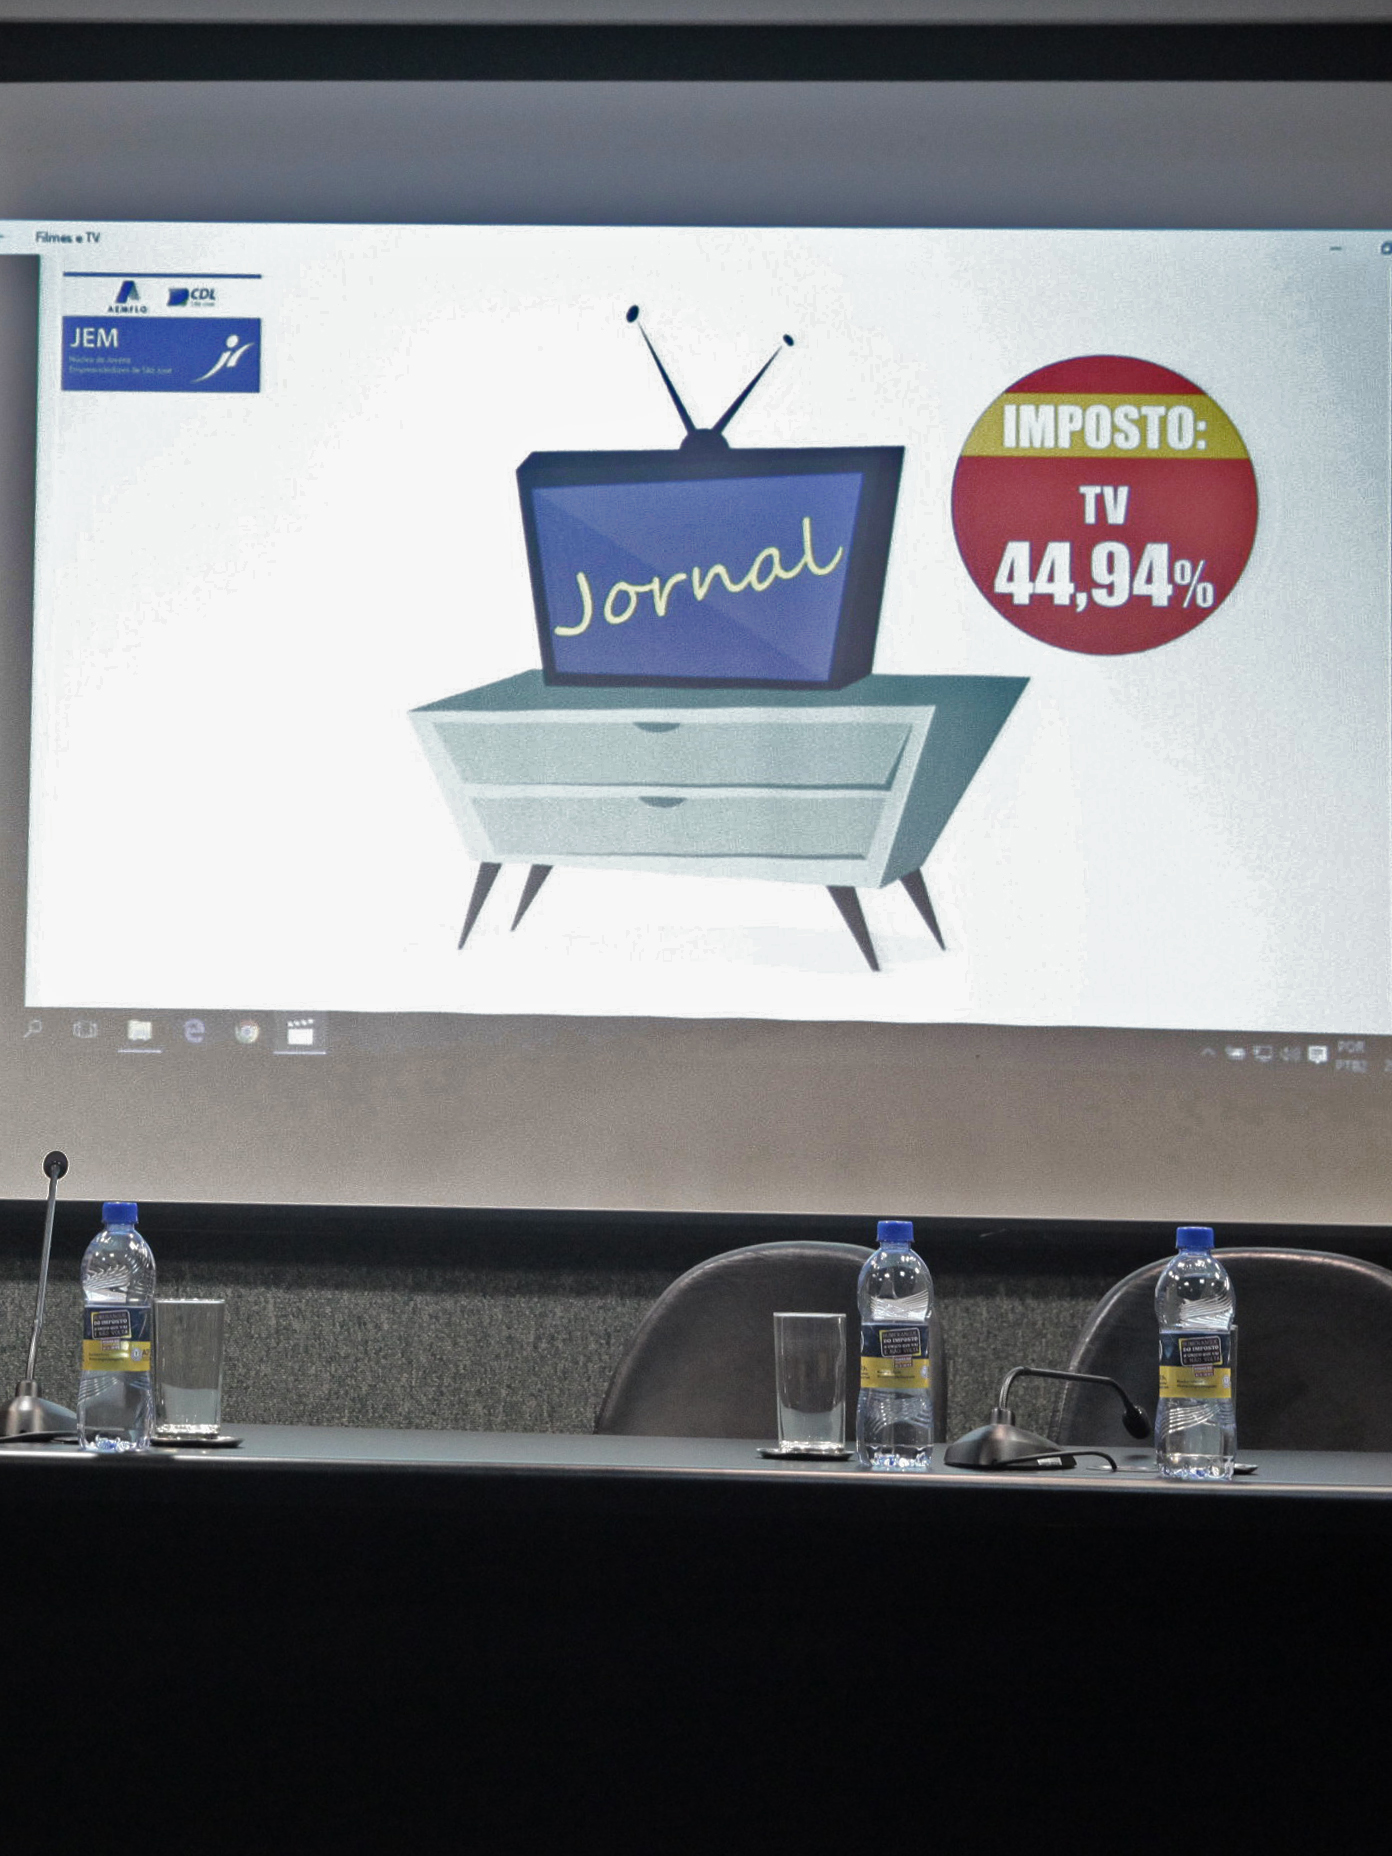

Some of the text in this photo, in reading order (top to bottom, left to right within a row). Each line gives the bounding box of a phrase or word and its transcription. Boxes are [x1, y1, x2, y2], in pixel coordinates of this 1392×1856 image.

[35, 230, 101, 244] Filmes e TV
[190, 287, 216, 301] CDL
[70, 327, 119, 348] JEM
[1002, 403, 1207, 451] IMPOSTO:
[1078, 484, 1130, 526] TV
[554, 516, 843, 636] Jornal
[993, 540, 1214, 613] 44,94%
